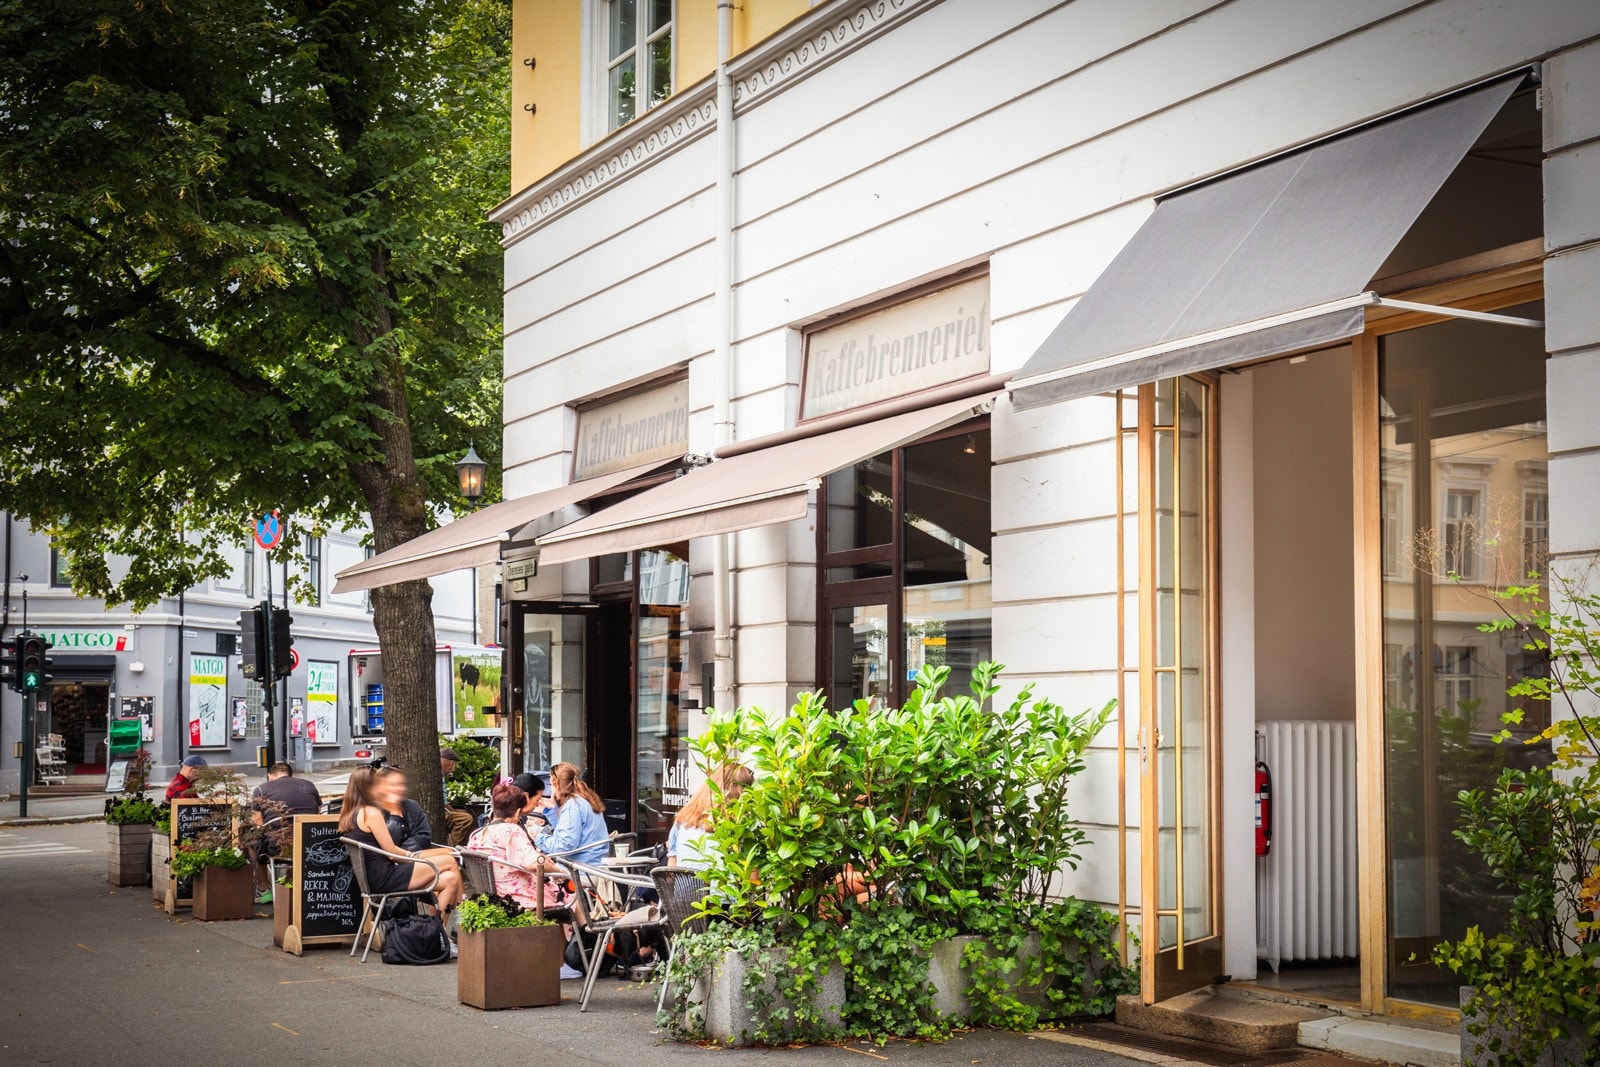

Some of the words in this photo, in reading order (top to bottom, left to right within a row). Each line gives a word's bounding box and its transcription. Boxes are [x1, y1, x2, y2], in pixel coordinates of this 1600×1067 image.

[811, 300, 988, 398] Kaffebrenneriet
[194, 659, 223, 674] MATGO
[308, 670, 322, 691] 24
[662, 758, 689, 789] Kaffe
[304, 880, 329, 890] REKER
[307, 891, 315, 902] &
[316, 892, 351, 902] MAJONES
